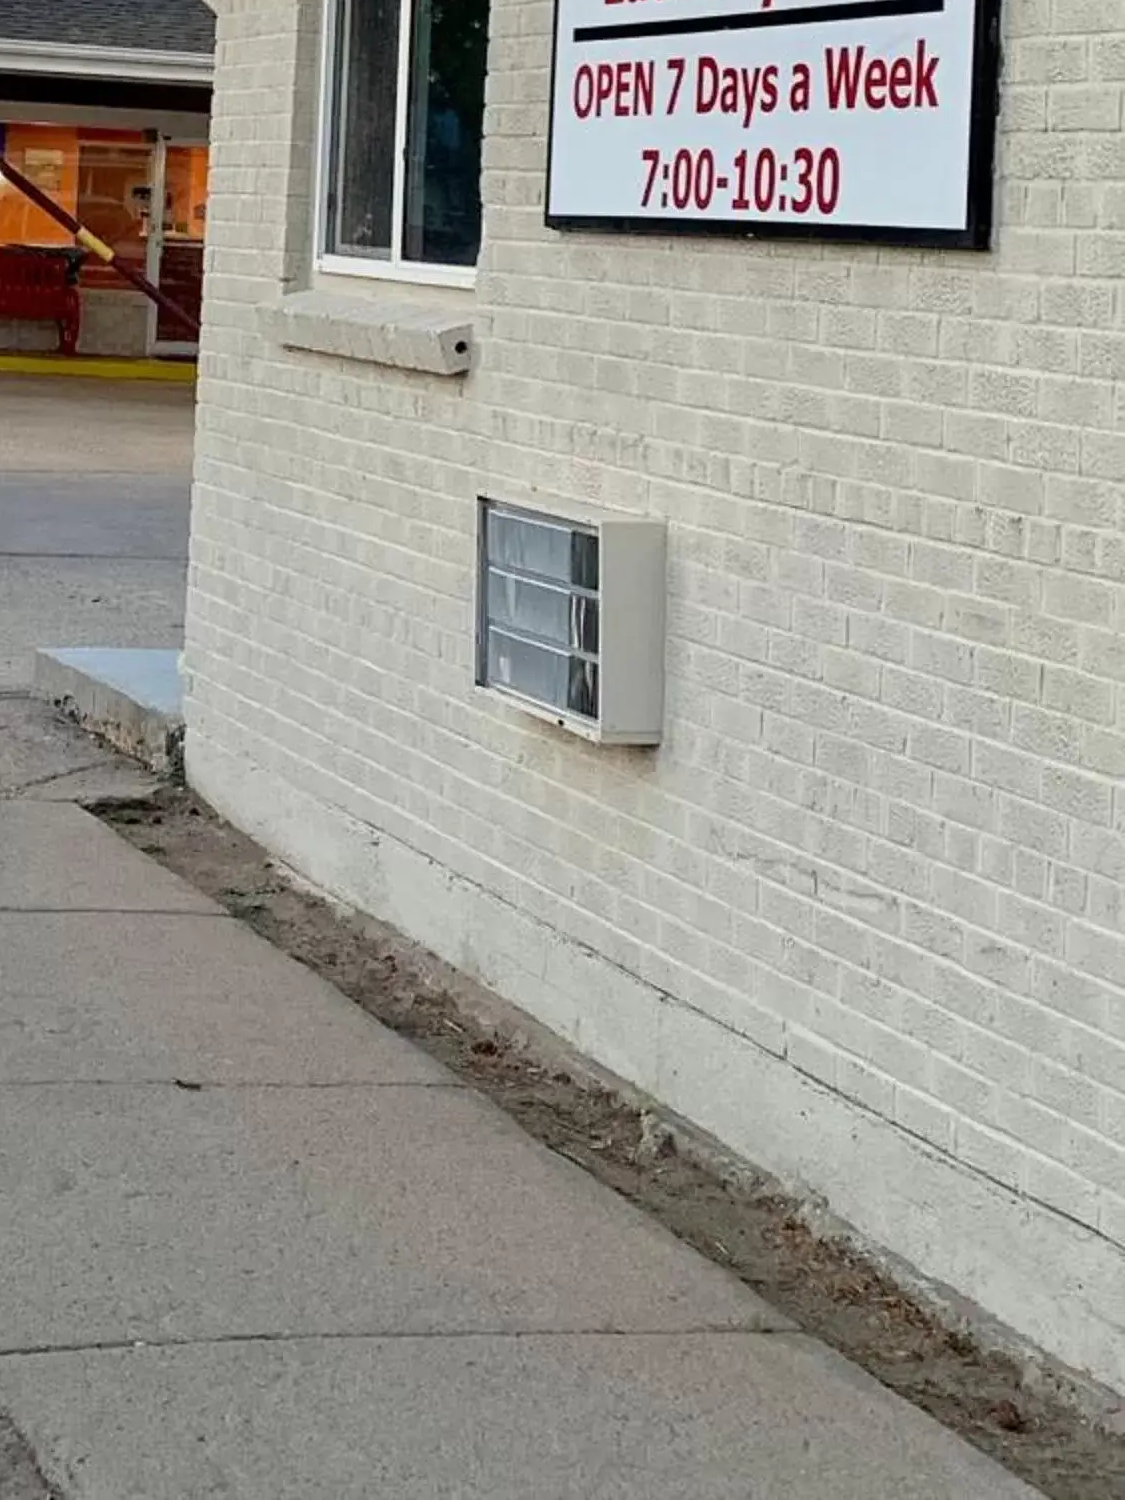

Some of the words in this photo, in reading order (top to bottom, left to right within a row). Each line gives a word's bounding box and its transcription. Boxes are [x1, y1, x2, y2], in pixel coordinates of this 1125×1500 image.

[574, 59, 655, 120] OPEN
[665, 58, 686, 115] 7
[695, 56, 779, 128] Days
[790, 61, 810, 111] a
[824, 38, 940, 111] Week
[640, 146, 841, 214] 7:00-10:30
